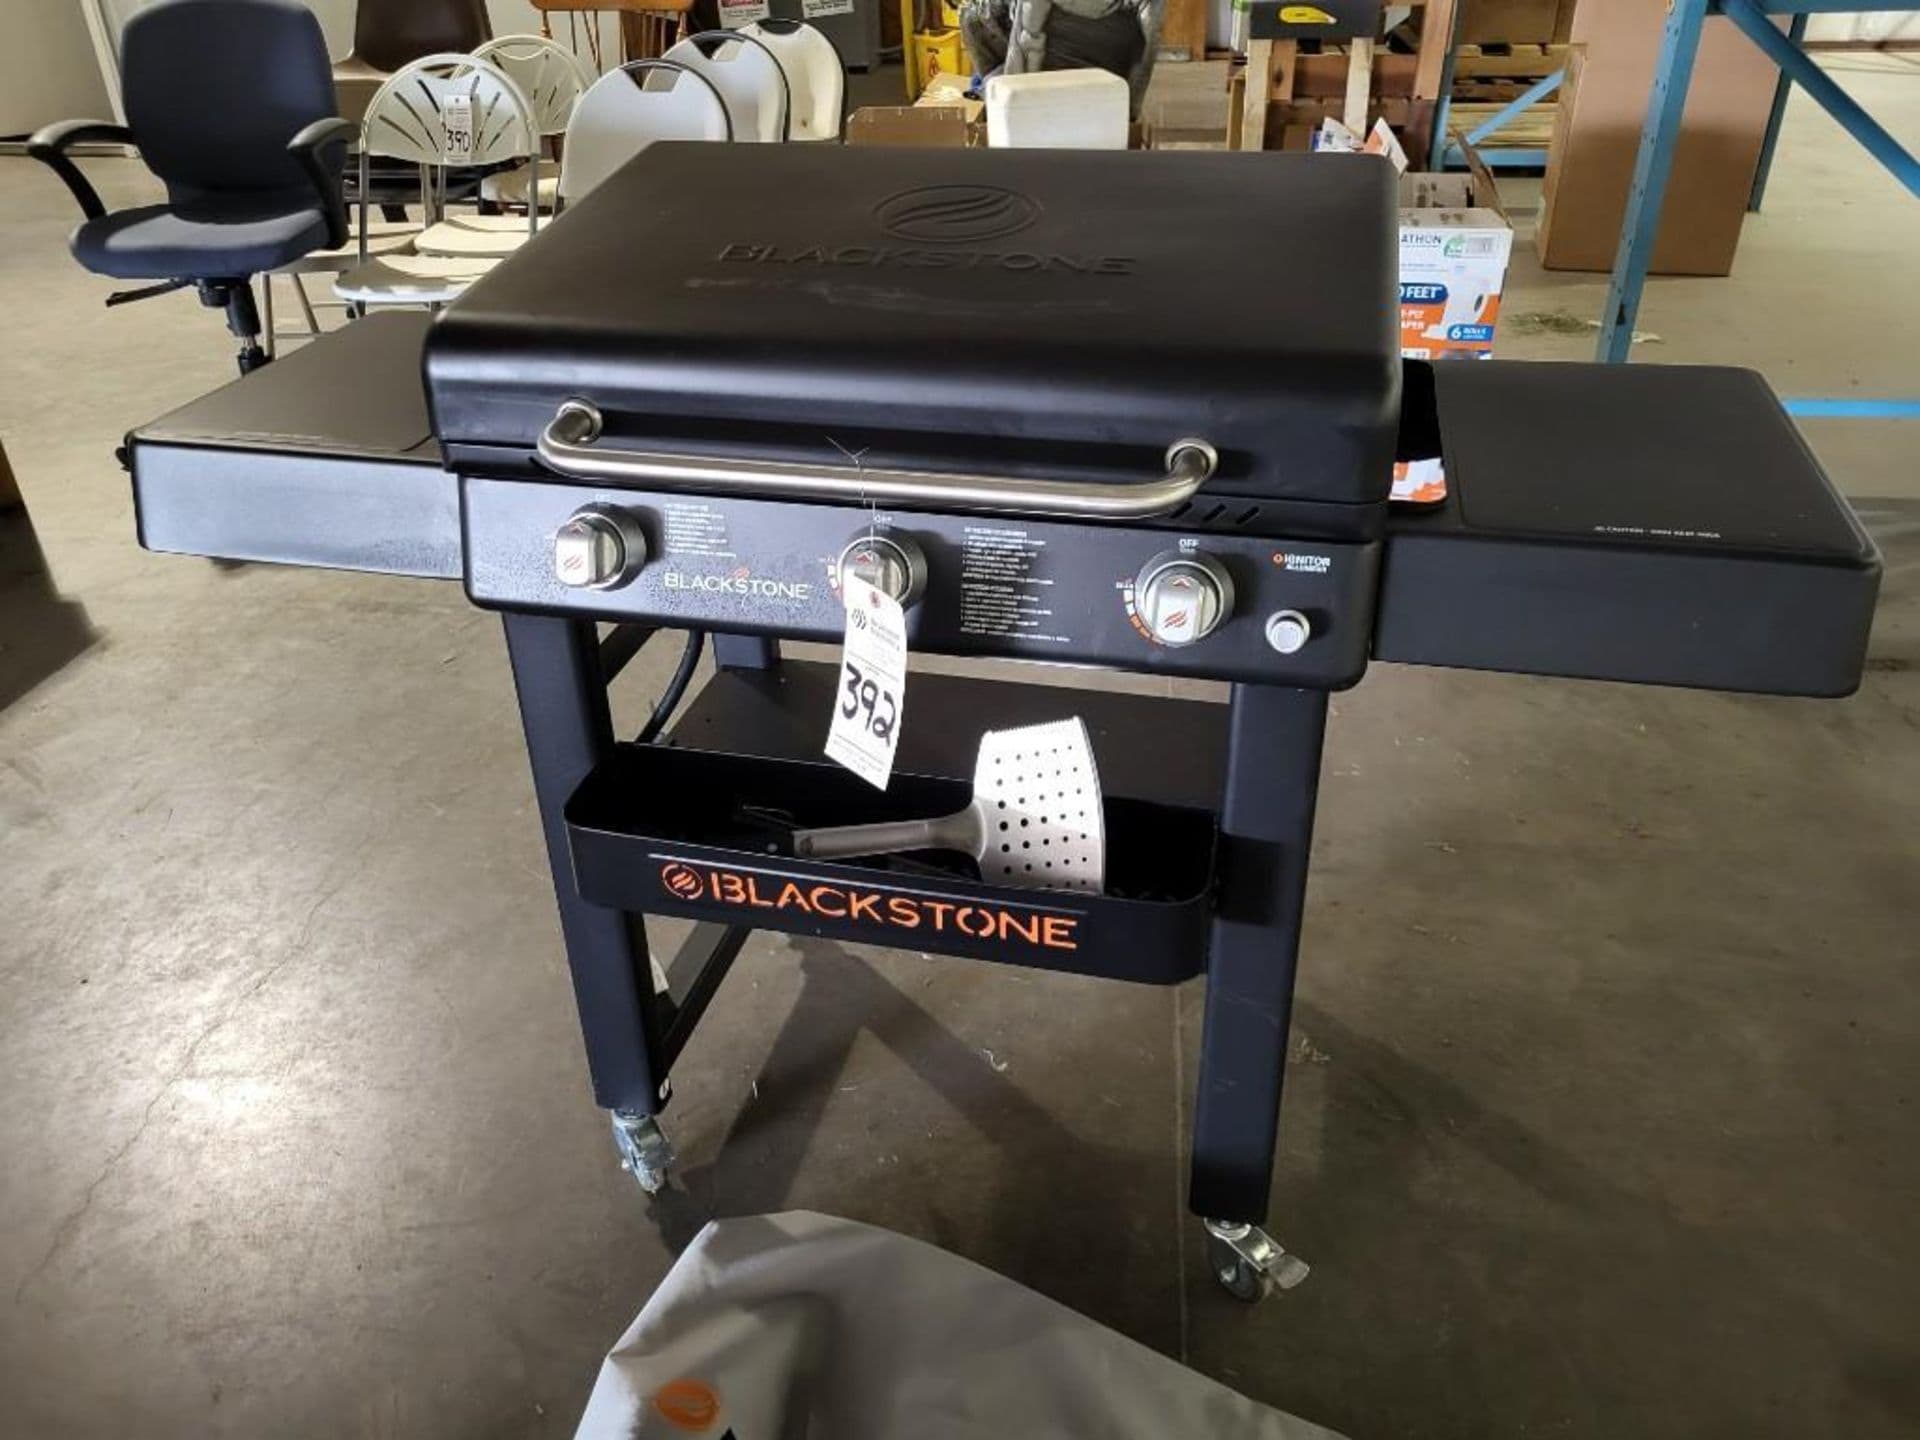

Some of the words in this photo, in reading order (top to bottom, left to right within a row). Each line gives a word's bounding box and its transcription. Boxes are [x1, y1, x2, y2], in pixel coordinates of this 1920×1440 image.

[447, 128, 471, 152] 390
[718, 243, 1137, 276] BLACKSTONE
[1451, 326, 1462, 339] 6
[664, 572, 810, 600] BLACKSTONE
[841, 661, 897, 748] 392
[711, 871, 1078, 950] BLACKSTONE
